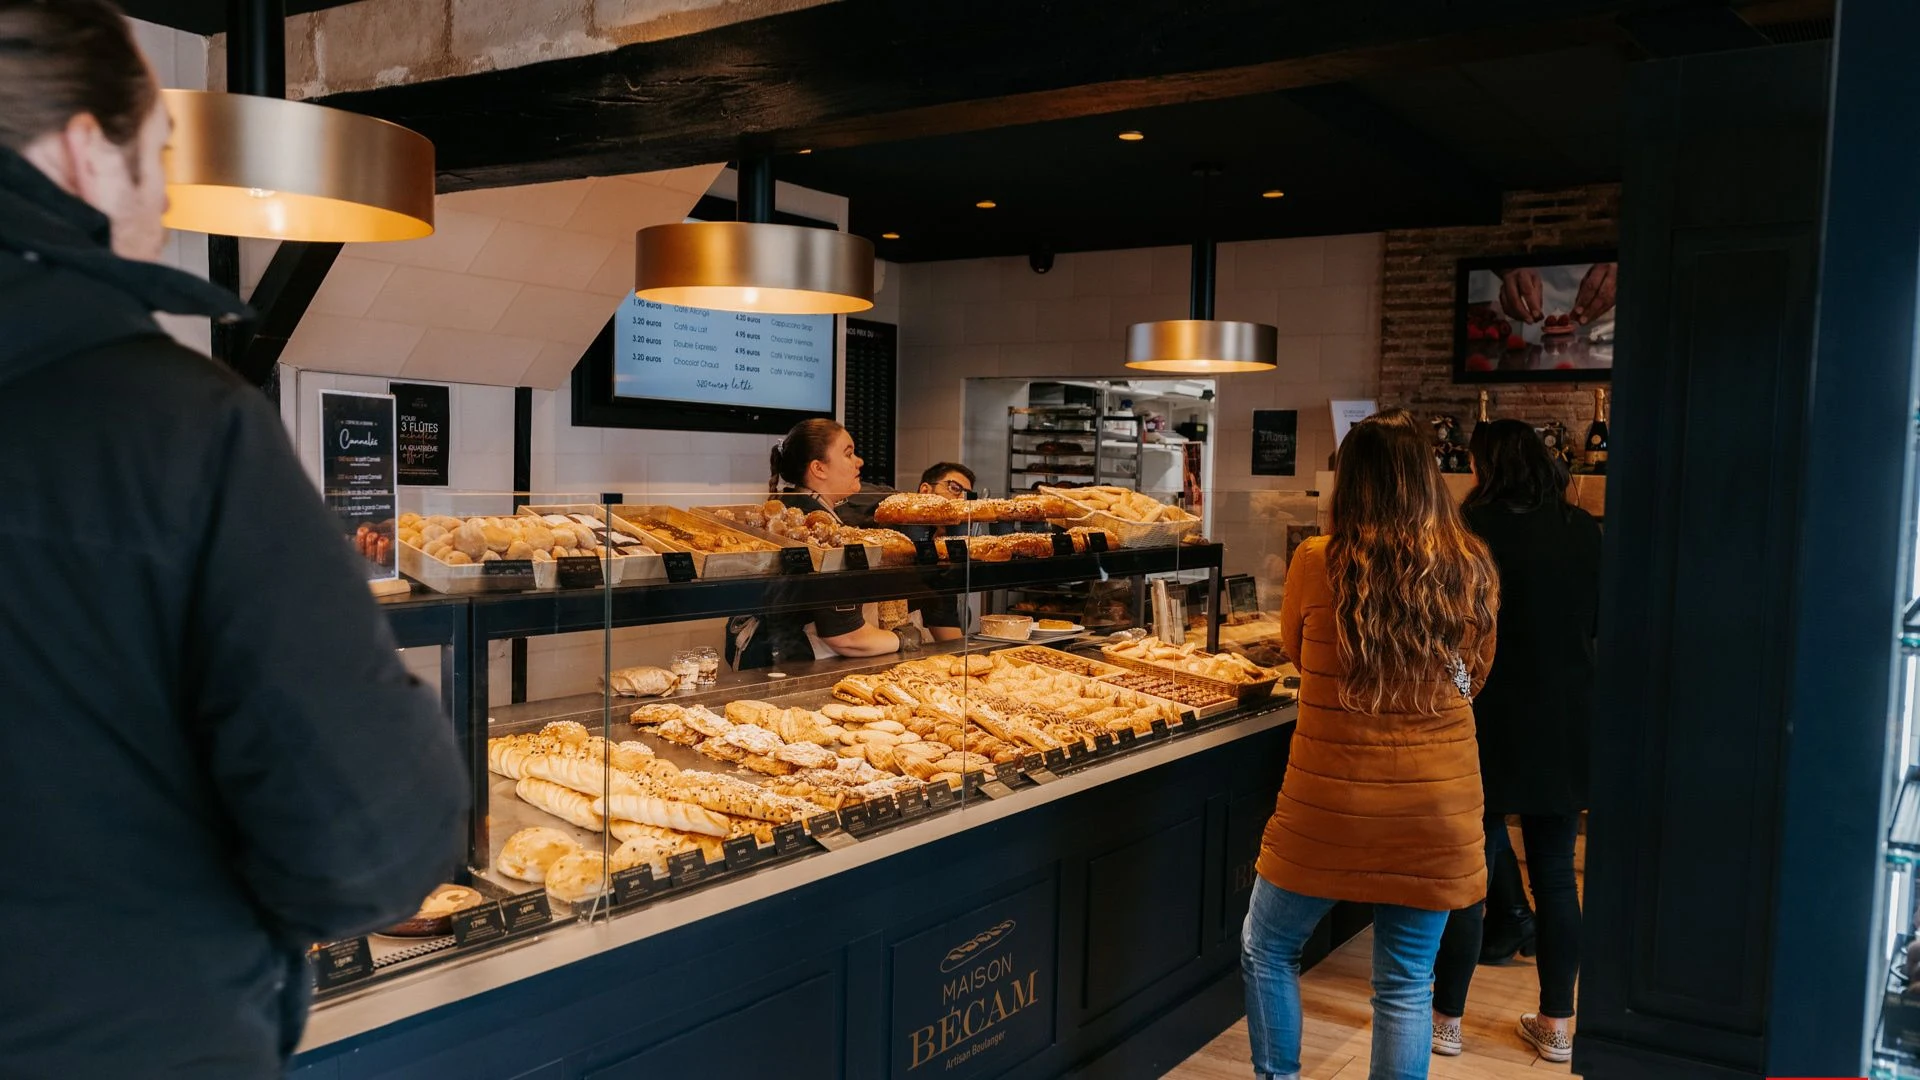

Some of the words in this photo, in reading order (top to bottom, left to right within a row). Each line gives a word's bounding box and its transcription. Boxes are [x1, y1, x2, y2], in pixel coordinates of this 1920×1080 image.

[646, 302, 662, 310] euros
[632, 316, 645, 326] 3.20
[646, 320, 662, 328] euros
[674, 322, 688, 331] Café
[632, 334, 645, 344] 3.20
[646, 337, 662, 346] euros
[746, 332, 760, 340] euros
[674, 340, 694, 349] Double
[632, 352, 645, 361] 3.20
[646, 355, 662, 363] euros
[746, 349, 760, 357] euros
[674, 357, 699, 366] Chocolat
[700, 360, 719, 369] Chaud
[746, 365, 760, 374] euros
[401, 422, 407, 432] 3
[410, 421, 438, 433] FLÛTES
[340, 428, 378, 449] Cannelés
[943, 952, 1012, 1006] MAISON
[907, 969, 1040, 1071] BÉCAM
[945, 1048, 971, 1071] Artisan
[972, 1030, 1006, 1056] Boulanger
